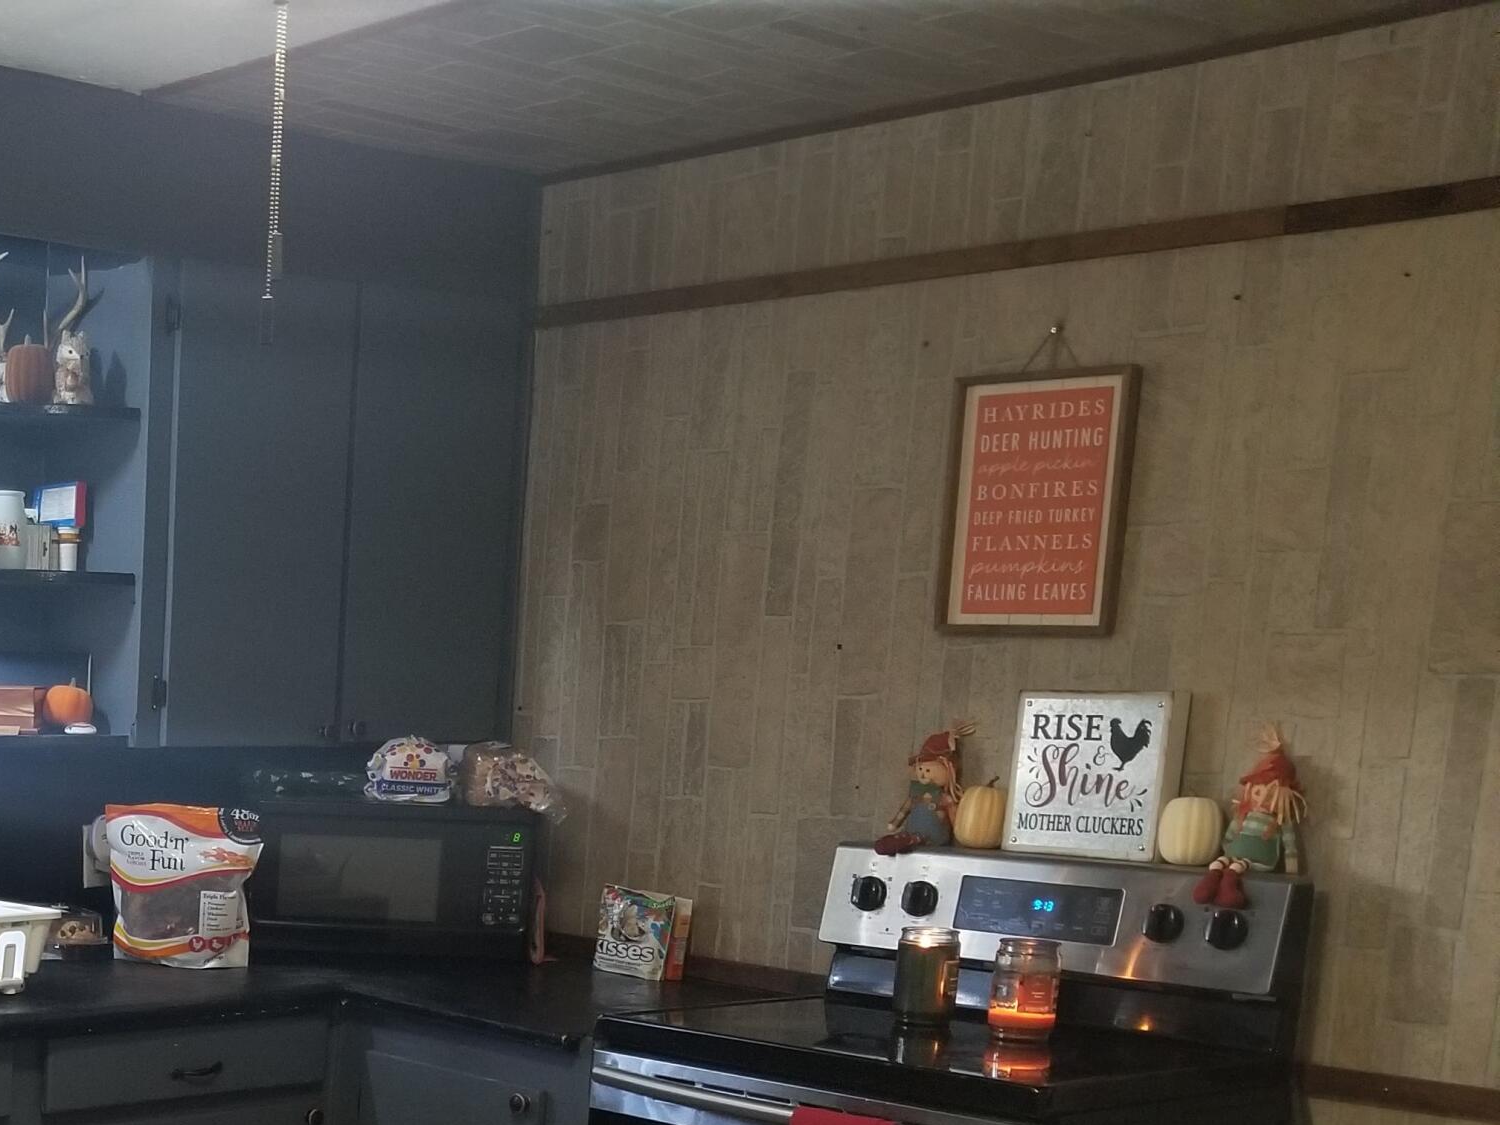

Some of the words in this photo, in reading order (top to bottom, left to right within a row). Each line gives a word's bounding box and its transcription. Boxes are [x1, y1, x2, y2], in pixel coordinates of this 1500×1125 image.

[984, 399, 1105, 423] HAYRIDES
[980, 432, 1020, 453] DEER
[1028, 427, 1104, 450] HUNTING
[977, 454, 1029, 476] apple
[977, 480, 1099, 500] BONFIRES
[973, 510, 1003, 526] DEEP
[1008, 509, 1043, 525] FRIED
[1048, 507, 1096, 524] TURKEY
[972, 534, 1093, 552] FLANNELS
[968, 553, 1084, 579] pumpkins
[967, 583, 1026, 601] FALLING
[1034, 582, 1087, 600] LEAVES
[1030, 714, 1104, 741] RISE
[1093, 745, 1109, 766] &
[390, 769, 436, 781] WONDER
[1025, 743, 1134, 808] Shine
[381, 783, 415, 793] CLASSIC
[1017, 812, 1072, 833] MOTHER
[1076, 815, 1144, 836] CLUCKERS
[512, 832, 521, 842] 8
[149, 849, 185, 871] Fun
